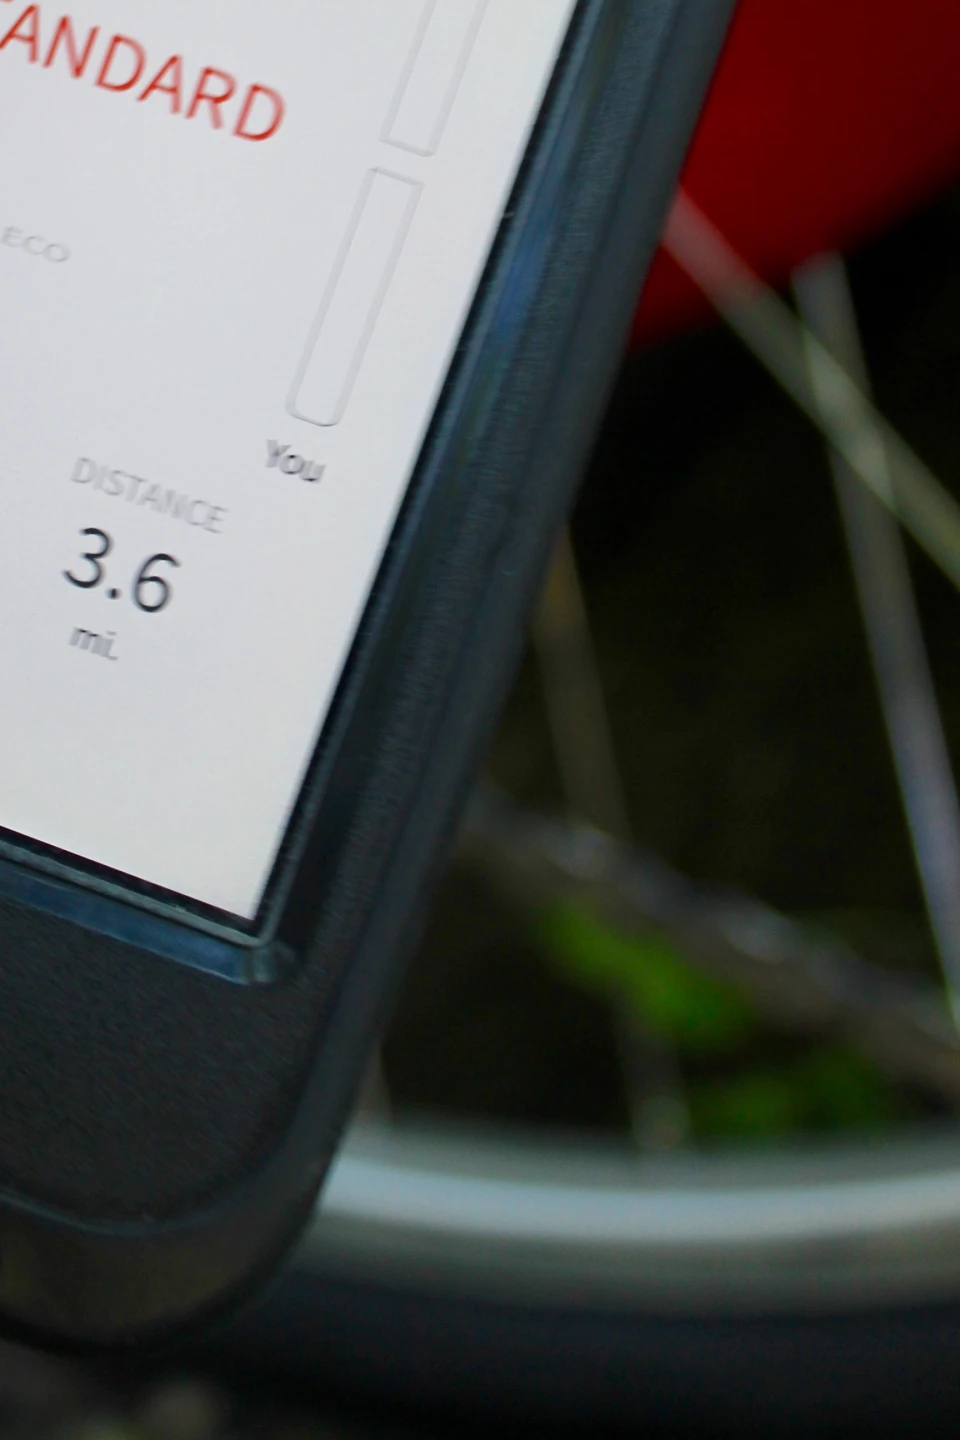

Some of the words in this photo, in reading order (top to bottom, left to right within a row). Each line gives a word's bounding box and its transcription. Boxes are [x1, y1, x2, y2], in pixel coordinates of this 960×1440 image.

[0, 225, 71, 264] ECO
[264, 438, 327, 485] You
[69, 456, 230, 534] DISTANCE
[62, 526, 182, 613] 3.6
